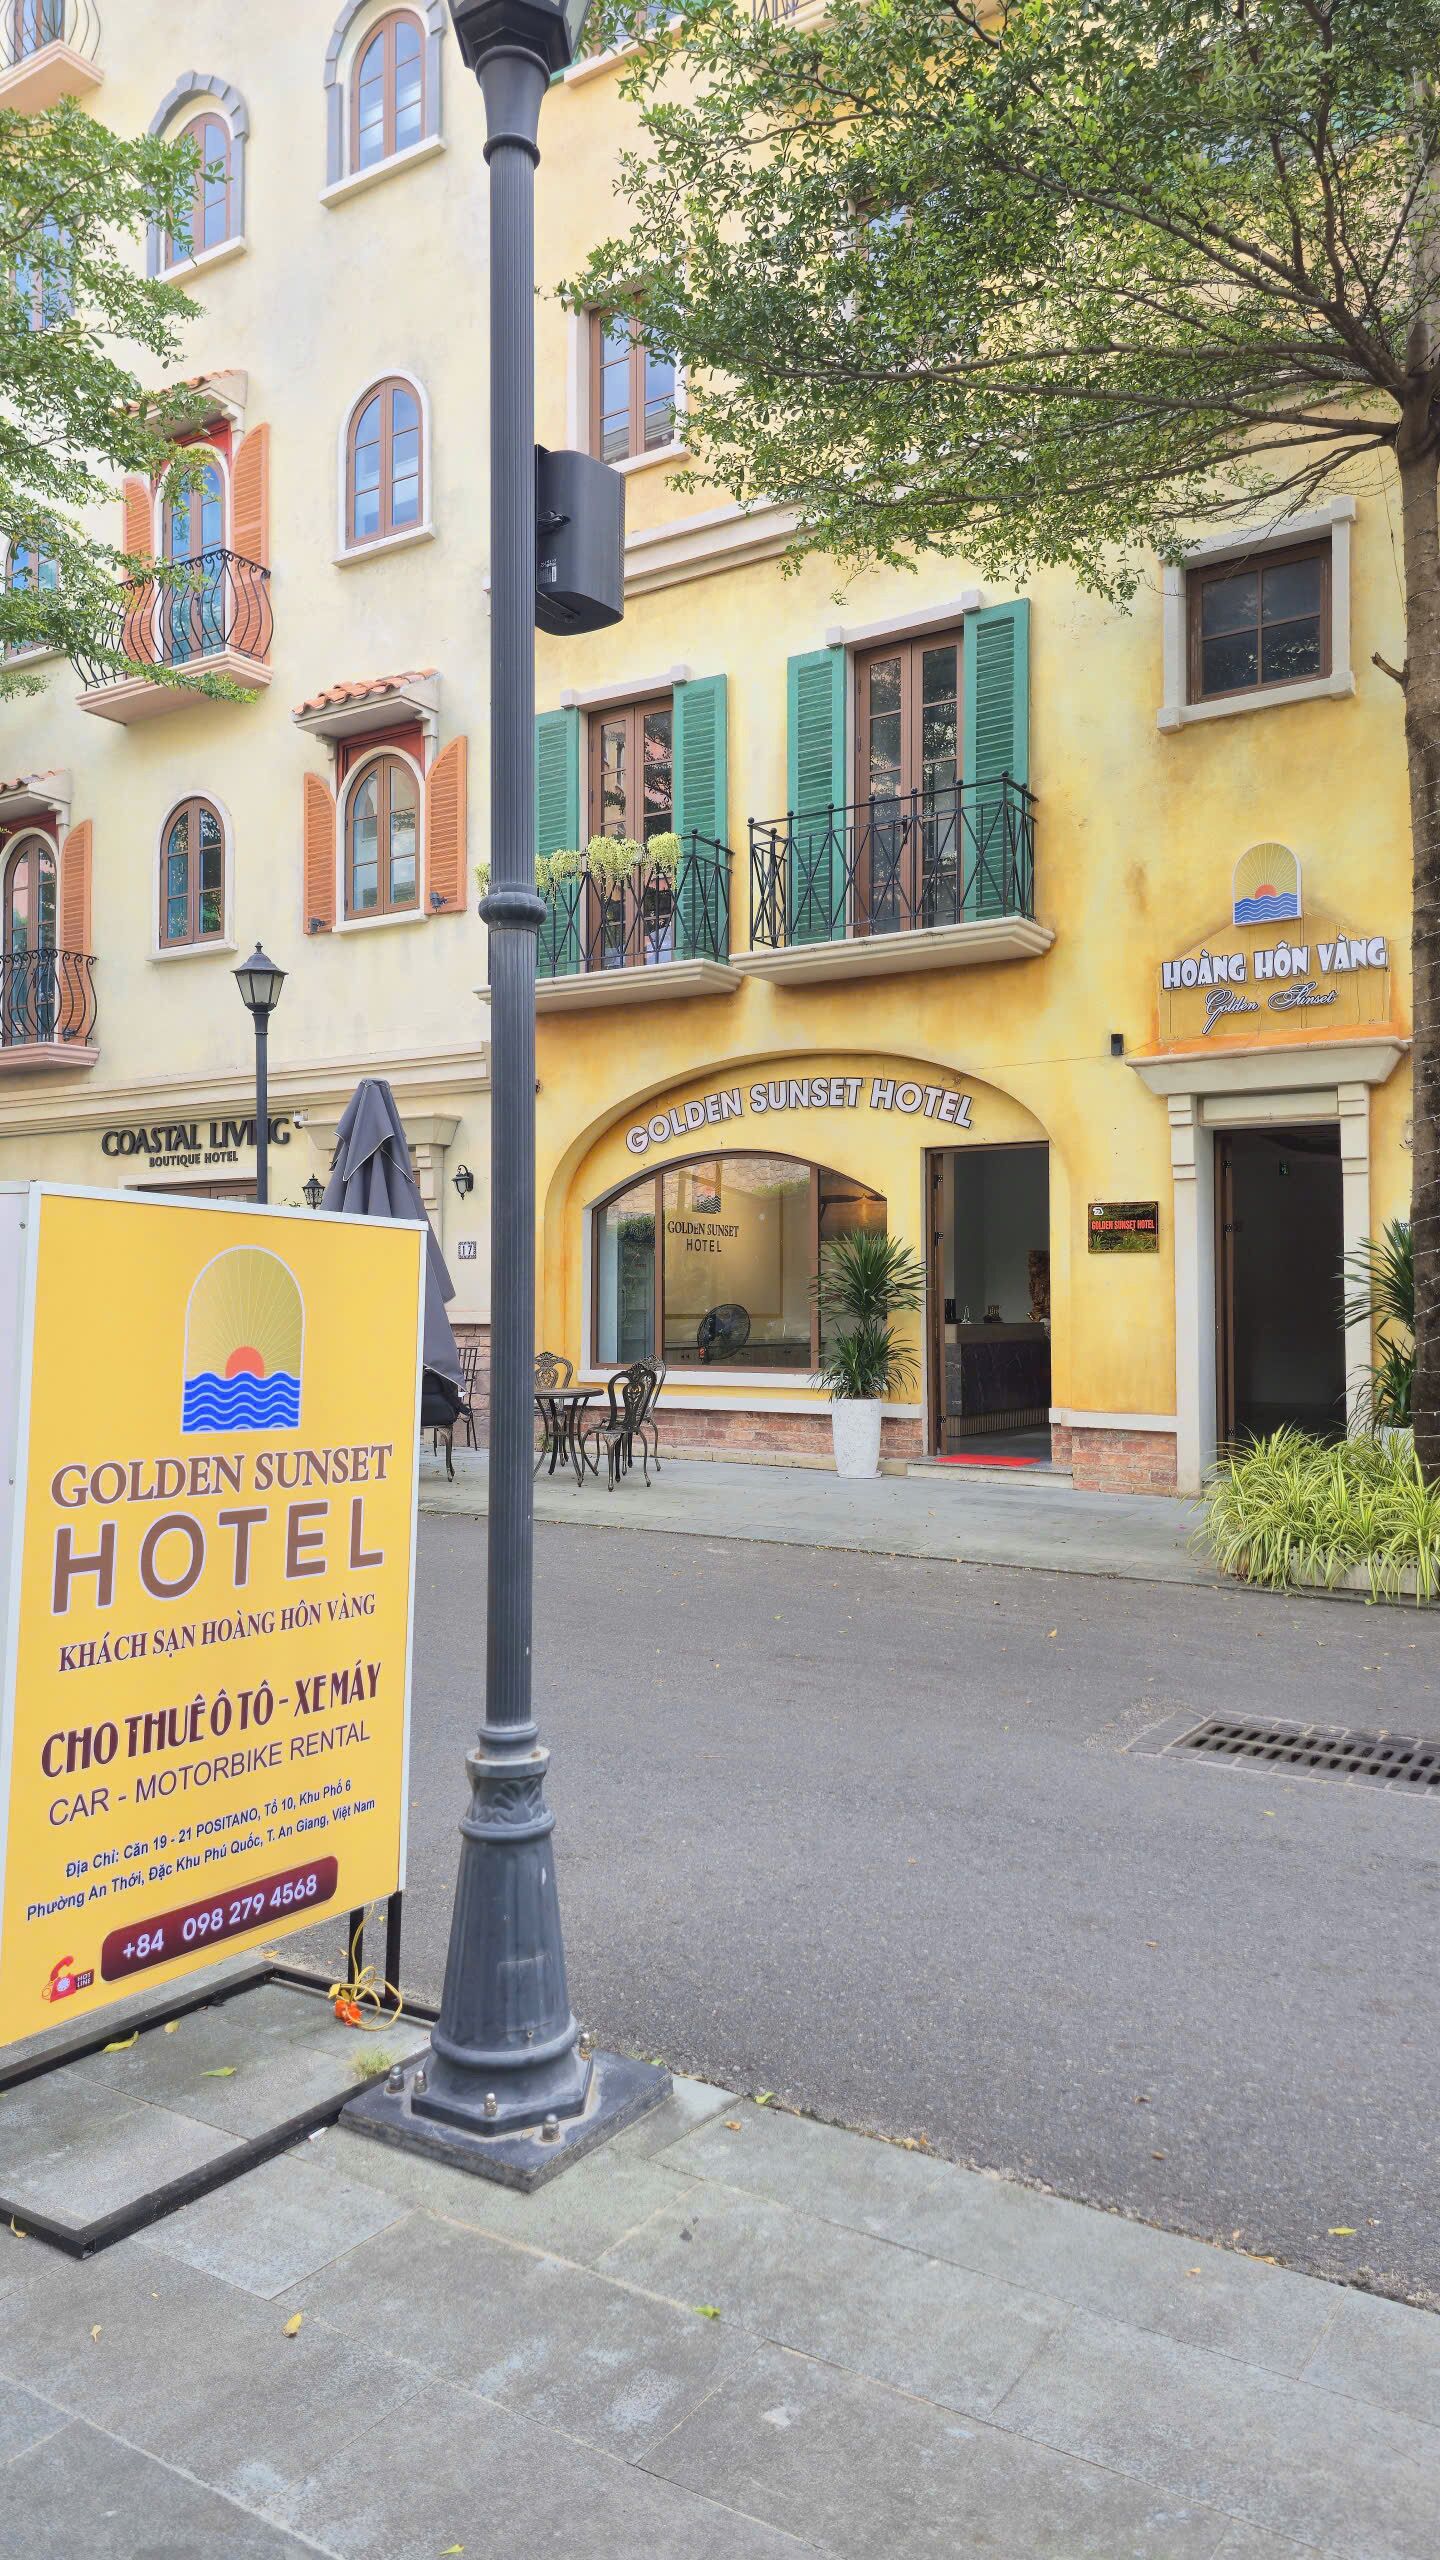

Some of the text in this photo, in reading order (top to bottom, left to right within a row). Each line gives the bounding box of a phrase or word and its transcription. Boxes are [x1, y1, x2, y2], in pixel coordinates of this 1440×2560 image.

[1161, 933, 1388, 990] HOÀNG HÔN VÀNG
[1202, 981, 1338, 1034] Golden Sunset
[102, 1123, 201, 1156] COASTAL
[626, 1077, 974, 1154] GOLDEN SUNSET HOTEL
[149, 1151, 239, 1168] BOUTIQUE HOTEL
[667, 1221, 739, 1238] GOLDEN SUNSET
[686, 1238, 722, 1252] HOTEL
[1091, 1219, 1155, 1231] GOLDEN SUNSET HOTEL
[50, 1444, 393, 1508] GOLDEN SUNSET
[50, 1496, 385, 1616] HOTEL
[58, 1592, 376, 1672] KHÁCH SẠN HOÀNG HÔN VÀNG
[41, 1721, 119, 1778] CHO
[124, 1693, 206, 1758] THUÊ
[210, 1688, 232, 1737] Ô
[237, 1680, 274, 1731] TÔ
[294, 1675, 327, 1718] XE
[330, 1659, 381, 1709] MÁY
[49, 1787, 109, 1826] CAR
[136, 1741, 283, 1803] MOTORBIKE
[290, 1720, 371, 1761] RENTAL
[66, 1860, 88, 1878] Địa
[124, 1842, 149, 1859] Căn
[153, 1835, 167, 1850] 19
[178, 1827, 192, 1843] 21
[197, 1807, 261, 1838] POSITANO,
[281, 1797, 296, 1811] 10,
[299, 1790, 320, 1806] Khu
[323, 1778, 343, 1798] Phố
[345, 1779, 351, 1791] 6
[27, 1799, 375, 1921] Phường An Thới, Đặc Khu Phú Quốc, T. An Giang, Việt Nam
[122, 1874, 317, 1960] +84 098 279 4568
[77, 1971, 91, 1981] HOT
[77, 1977, 91, 1988] LINE
